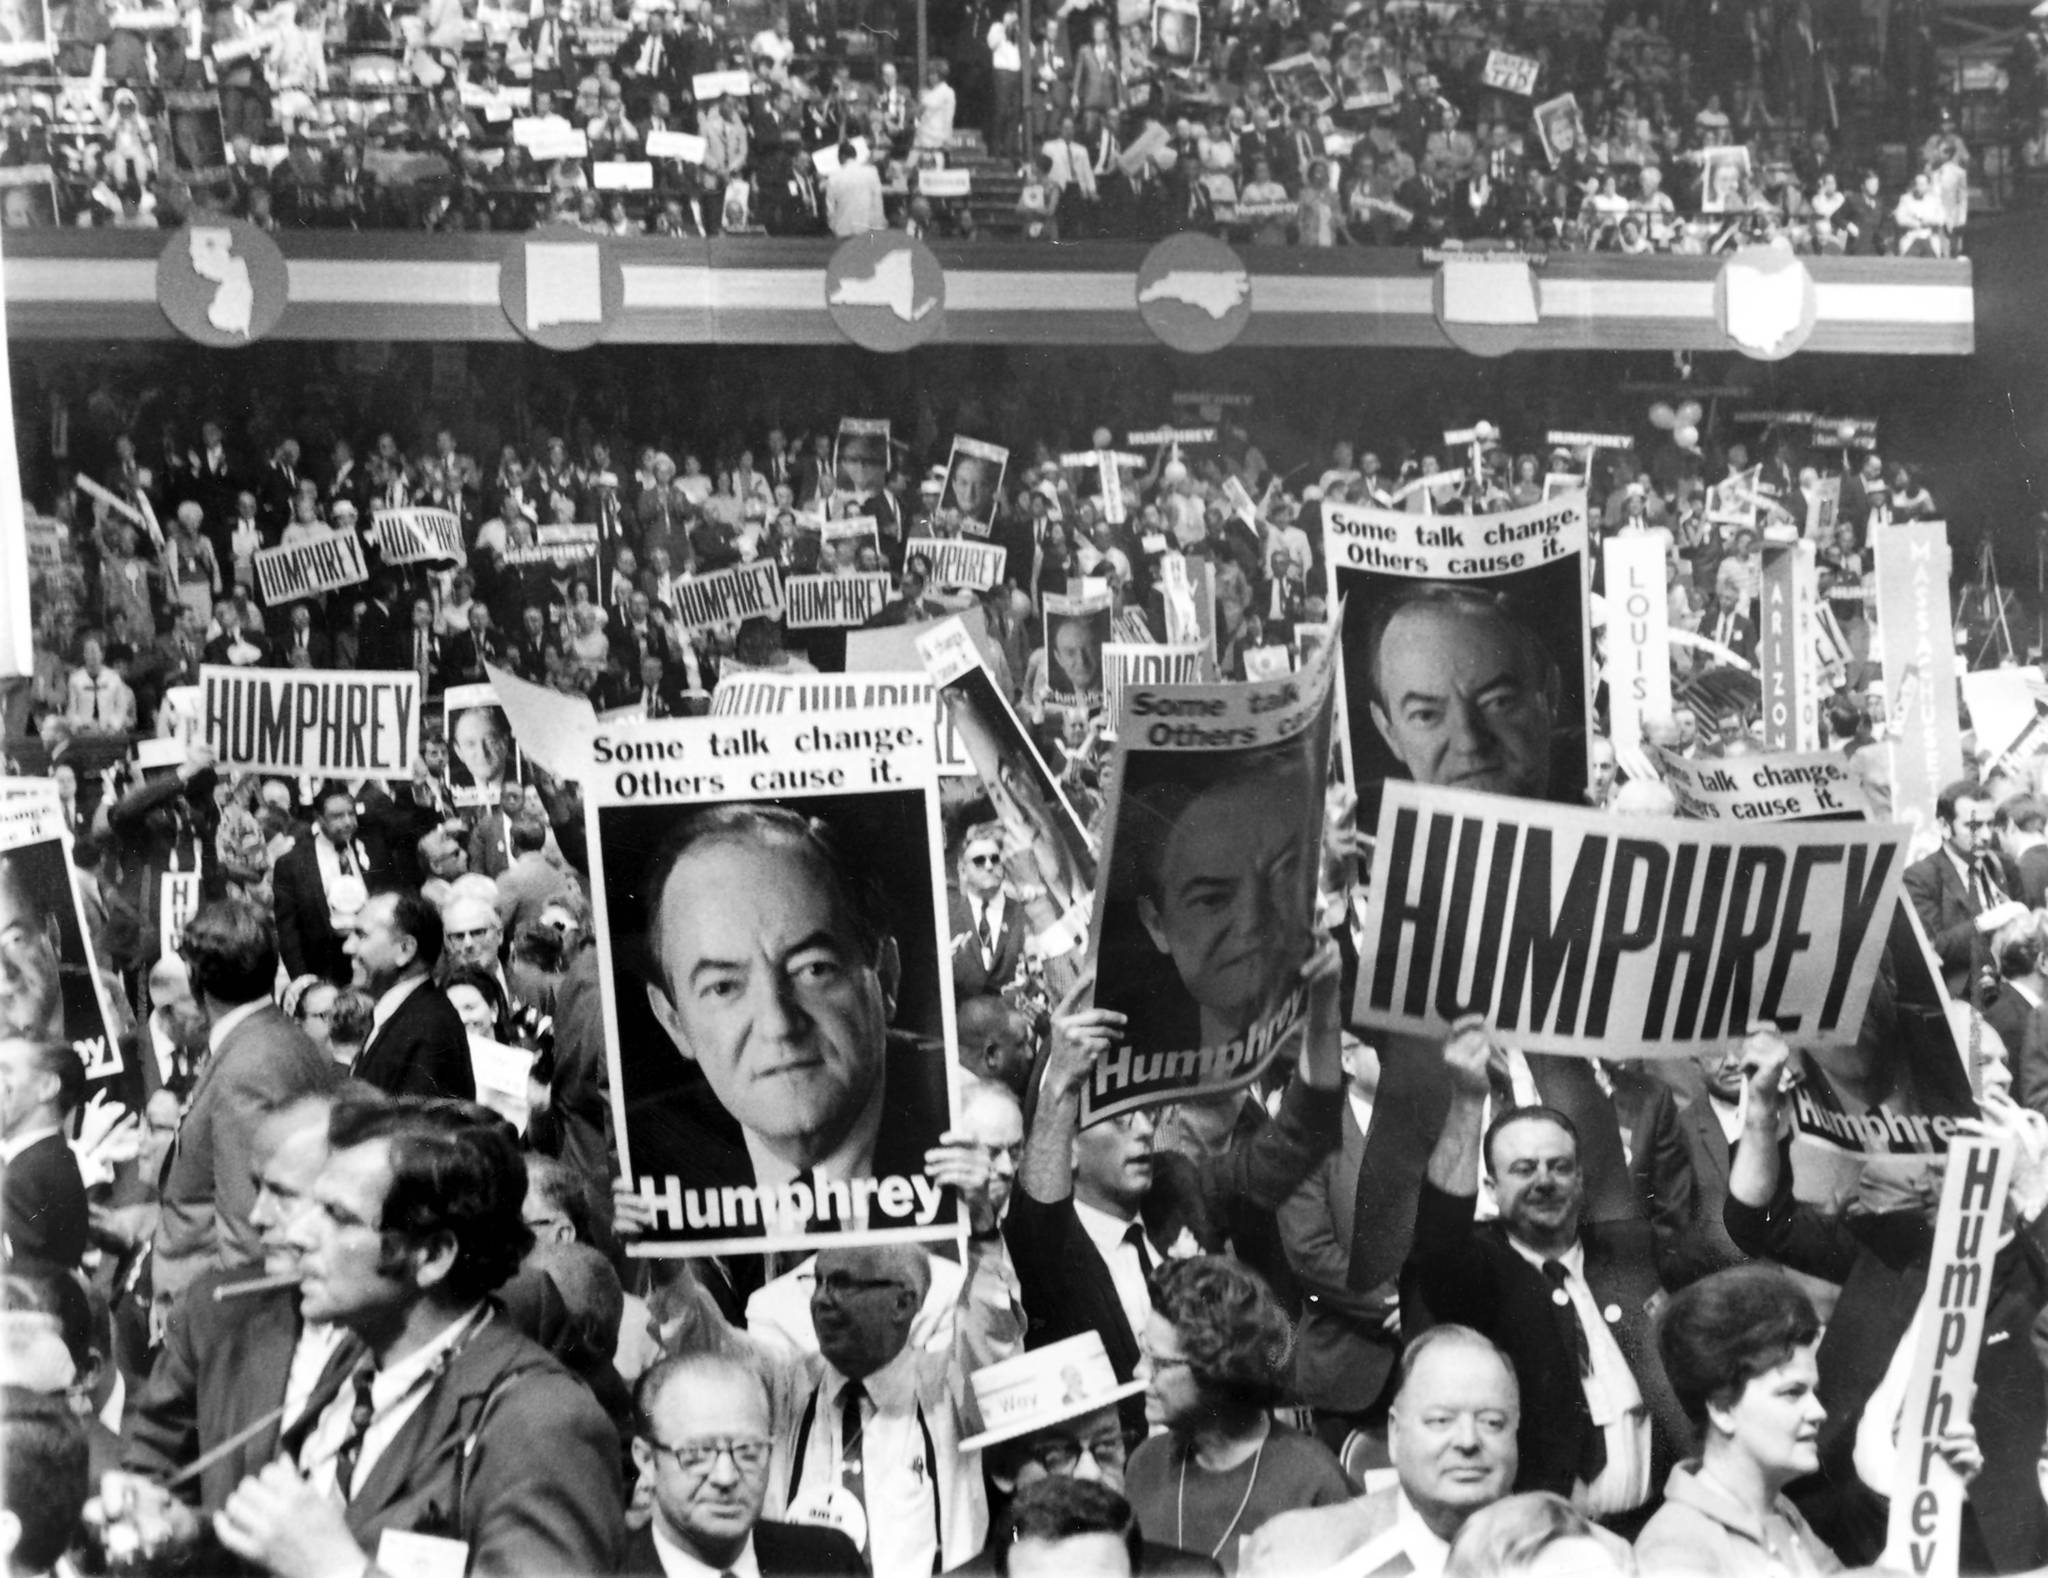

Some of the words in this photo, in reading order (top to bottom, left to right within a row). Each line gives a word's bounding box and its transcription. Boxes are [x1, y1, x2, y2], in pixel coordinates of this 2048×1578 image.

[1330, 512, 1397, 542] Some
[1415, 525, 1465, 547] talk
[1483, 508, 1581, 546] change.
[260, 534, 363, 599] HUMPHREY
[908, 543, 1002, 586] MPHREY
[1347, 543, 1428, 573] Others
[1447, 551, 1525, 574] cause
[1541, 539, 1566, 560] it.
[674, 564, 780, 628] HUMPHREY
[206, 678, 414, 768] HUMPHREY
[1131, 692, 1227, 717] Some
[593, 735, 684, 763] Some
[710, 728, 770, 757] talk
[795, 726, 924, 754] change.
[615, 770, 725, 798] Others
[750, 767, 845, 791] cause
[870, 758, 902, 785] it.
[1698, 769, 1738, 793] talk
[1752, 764, 1849, 789] change.
[1731, 796, 1802, 820] cause
[1814, 788, 1844, 810] it.
[1369, 808, 1897, 1042] HUMPHREY
[1795, 1087, 1958, 1152] Humphre
[641, 1166, 942, 1232] Humphrey
